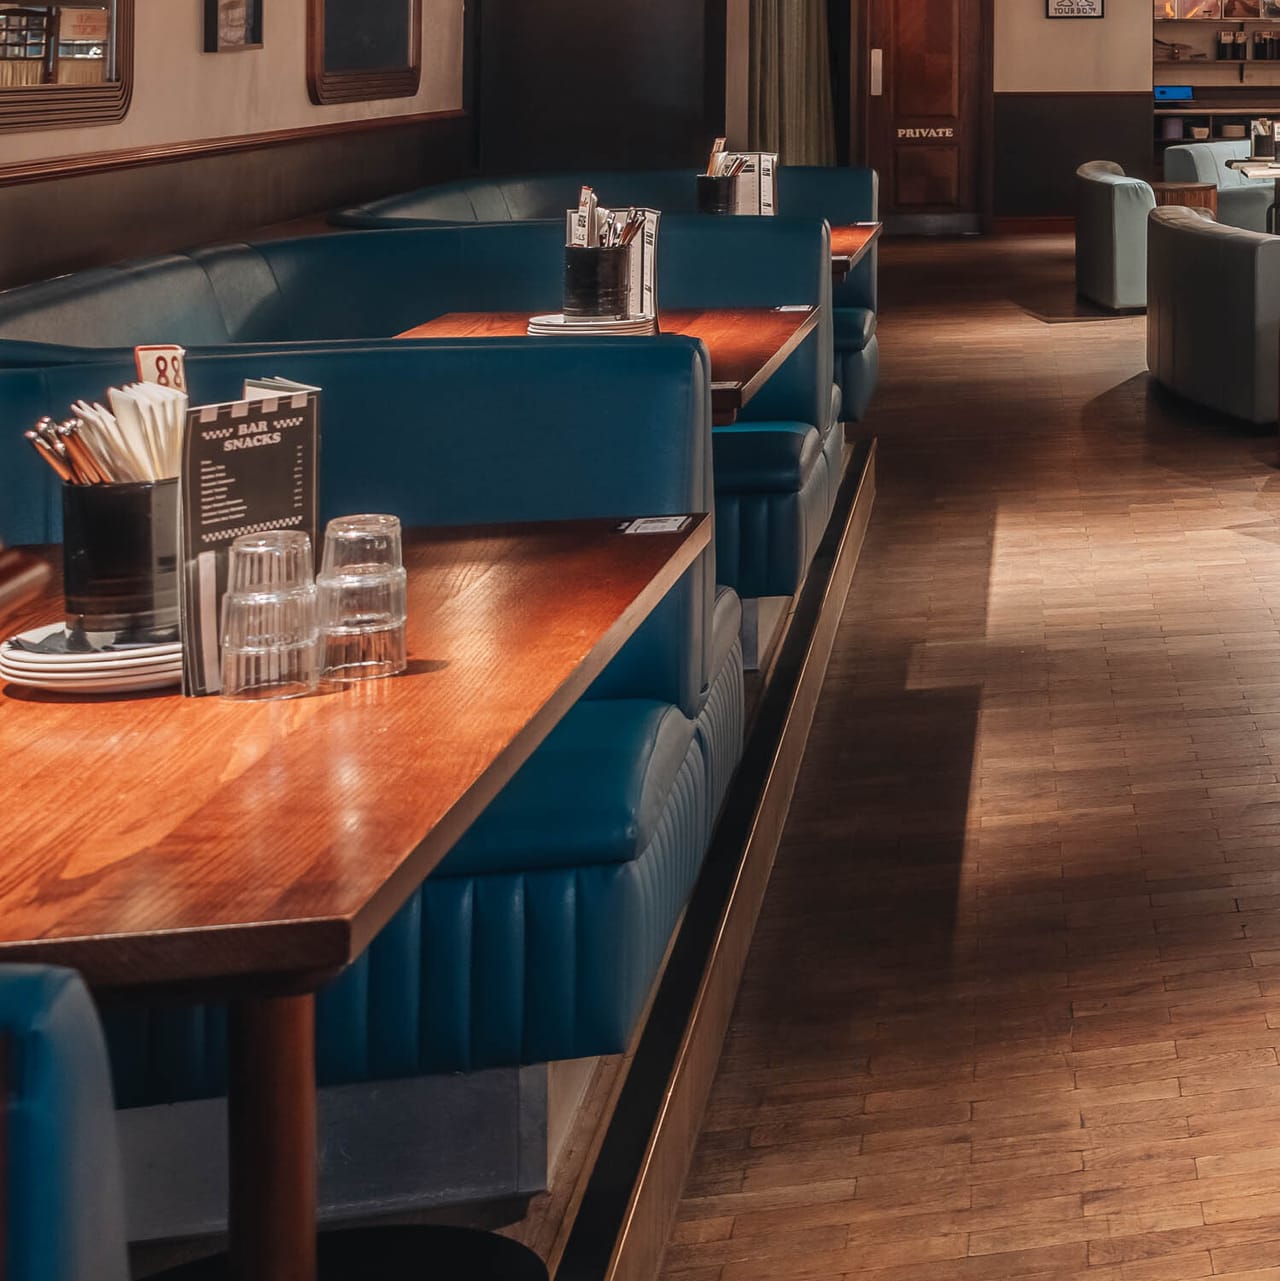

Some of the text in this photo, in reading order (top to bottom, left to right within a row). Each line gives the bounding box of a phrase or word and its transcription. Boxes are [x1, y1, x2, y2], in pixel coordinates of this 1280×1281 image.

[898, 128, 953, 138] PRIVATE
[238, 421, 269, 436] BAR
[223, 432, 281, 451] SNACKS
